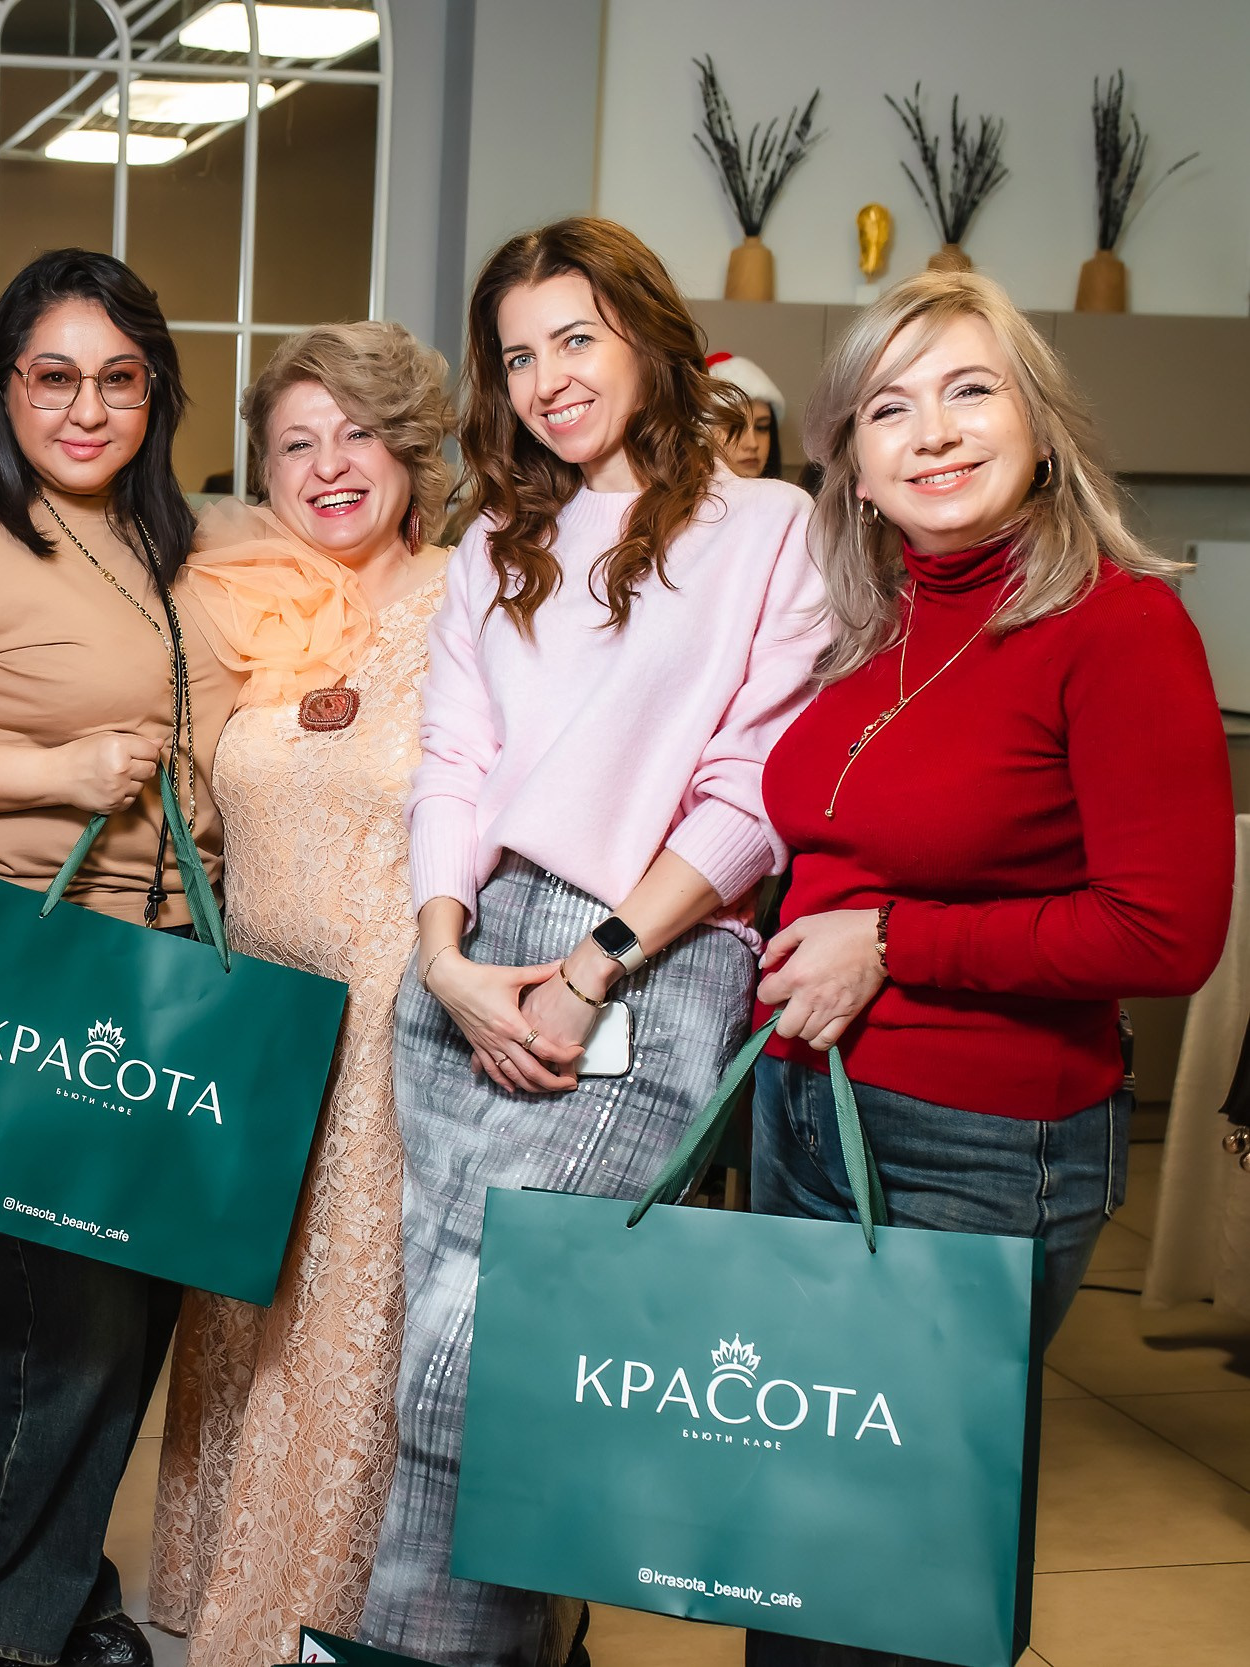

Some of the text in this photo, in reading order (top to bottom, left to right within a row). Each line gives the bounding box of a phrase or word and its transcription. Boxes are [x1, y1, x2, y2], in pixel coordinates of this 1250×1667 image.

[55, 1087, 134, 1116] БЬЮТИ КАФЕ
[15, 1200, 130, 1242] krasota_beauty_cafe
[575, 1354, 902, 1446] КРАСОТА
[682, 1429, 782, 1451] БЬЮТИ КАФЕ
[653, 1570, 803, 1608] krasota_beauty_cafe
